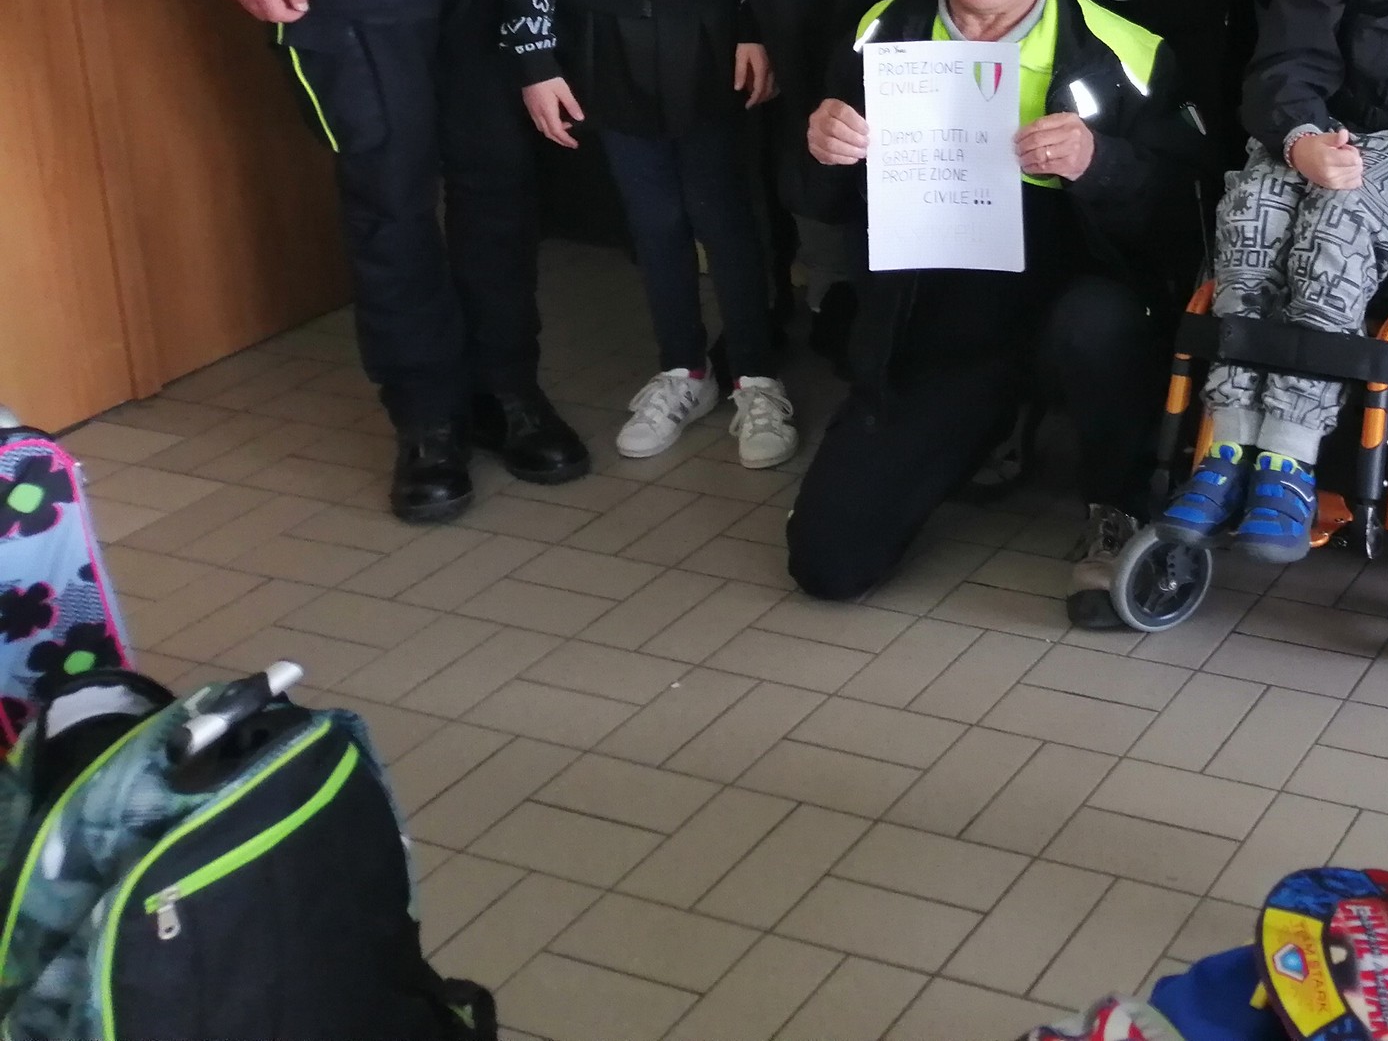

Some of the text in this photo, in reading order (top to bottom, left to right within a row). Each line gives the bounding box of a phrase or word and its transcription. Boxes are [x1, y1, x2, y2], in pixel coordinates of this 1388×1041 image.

[878, 60, 965, 77] PROTEZIONE
[881, 129, 923, 146] DIAMO
[928, 128, 968, 143] TUTTI
[882, 148, 964, 164] GRAZIE ALLA
[882, 167, 968, 183] PROTEZIONE
[1307, 959, 1330, 1015] STARK
